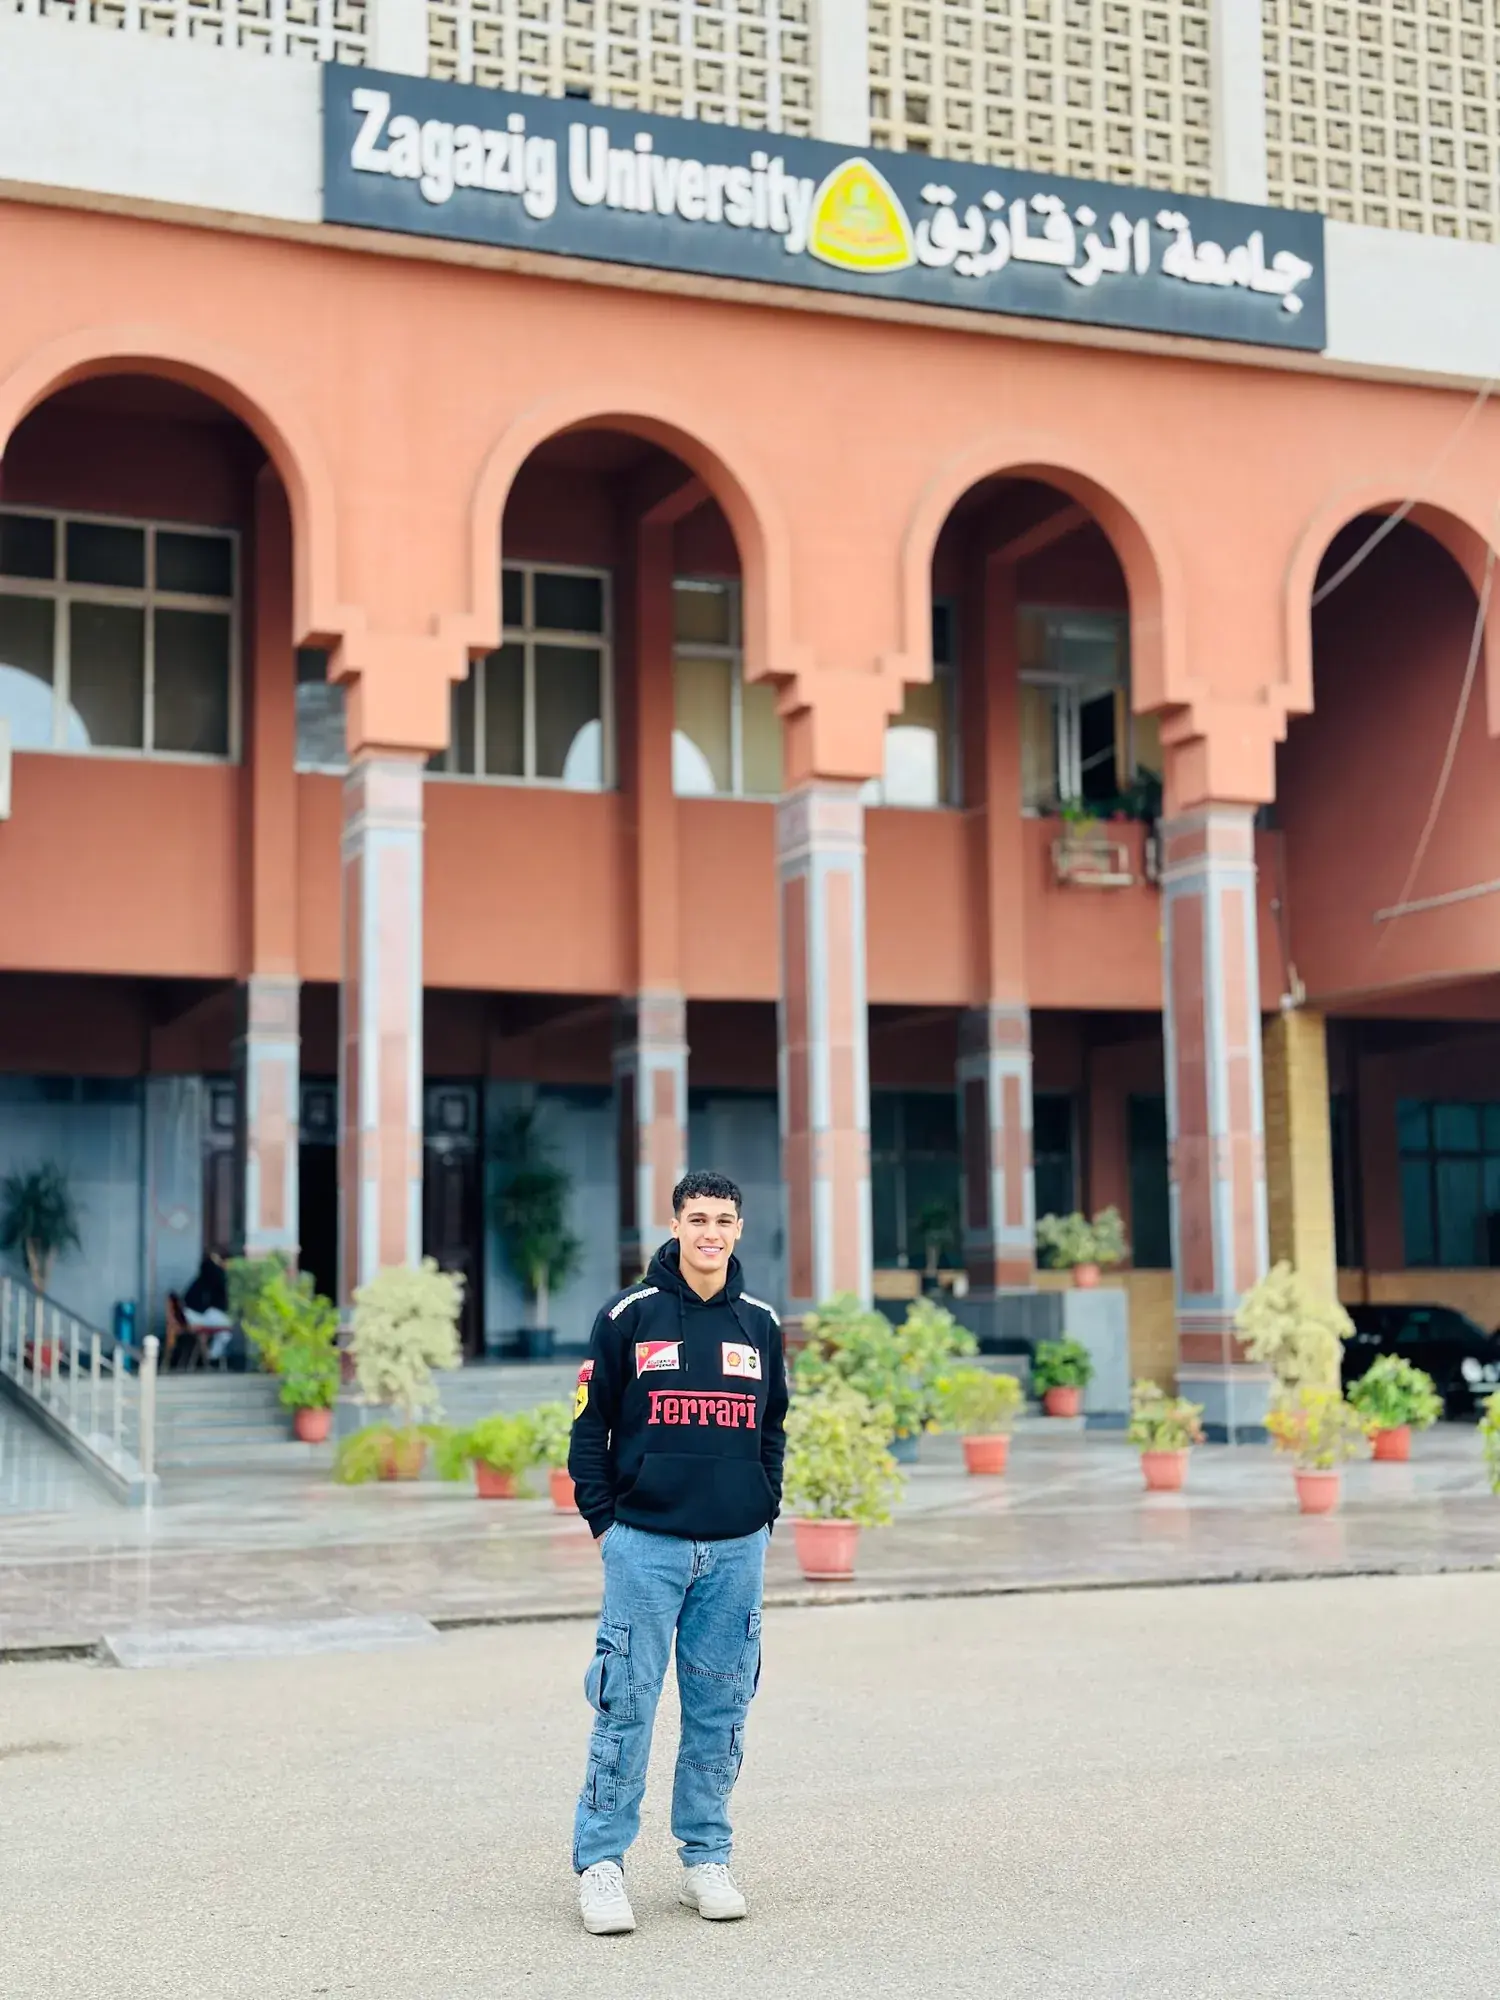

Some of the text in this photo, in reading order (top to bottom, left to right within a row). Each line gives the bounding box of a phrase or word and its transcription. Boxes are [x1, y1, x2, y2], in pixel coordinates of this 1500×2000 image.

[351, 87, 815, 254] Zagazig University
[914, 182, 1313, 314] جامعة الزقازيق
[647, 1390, 756, 1429] Ferrari
